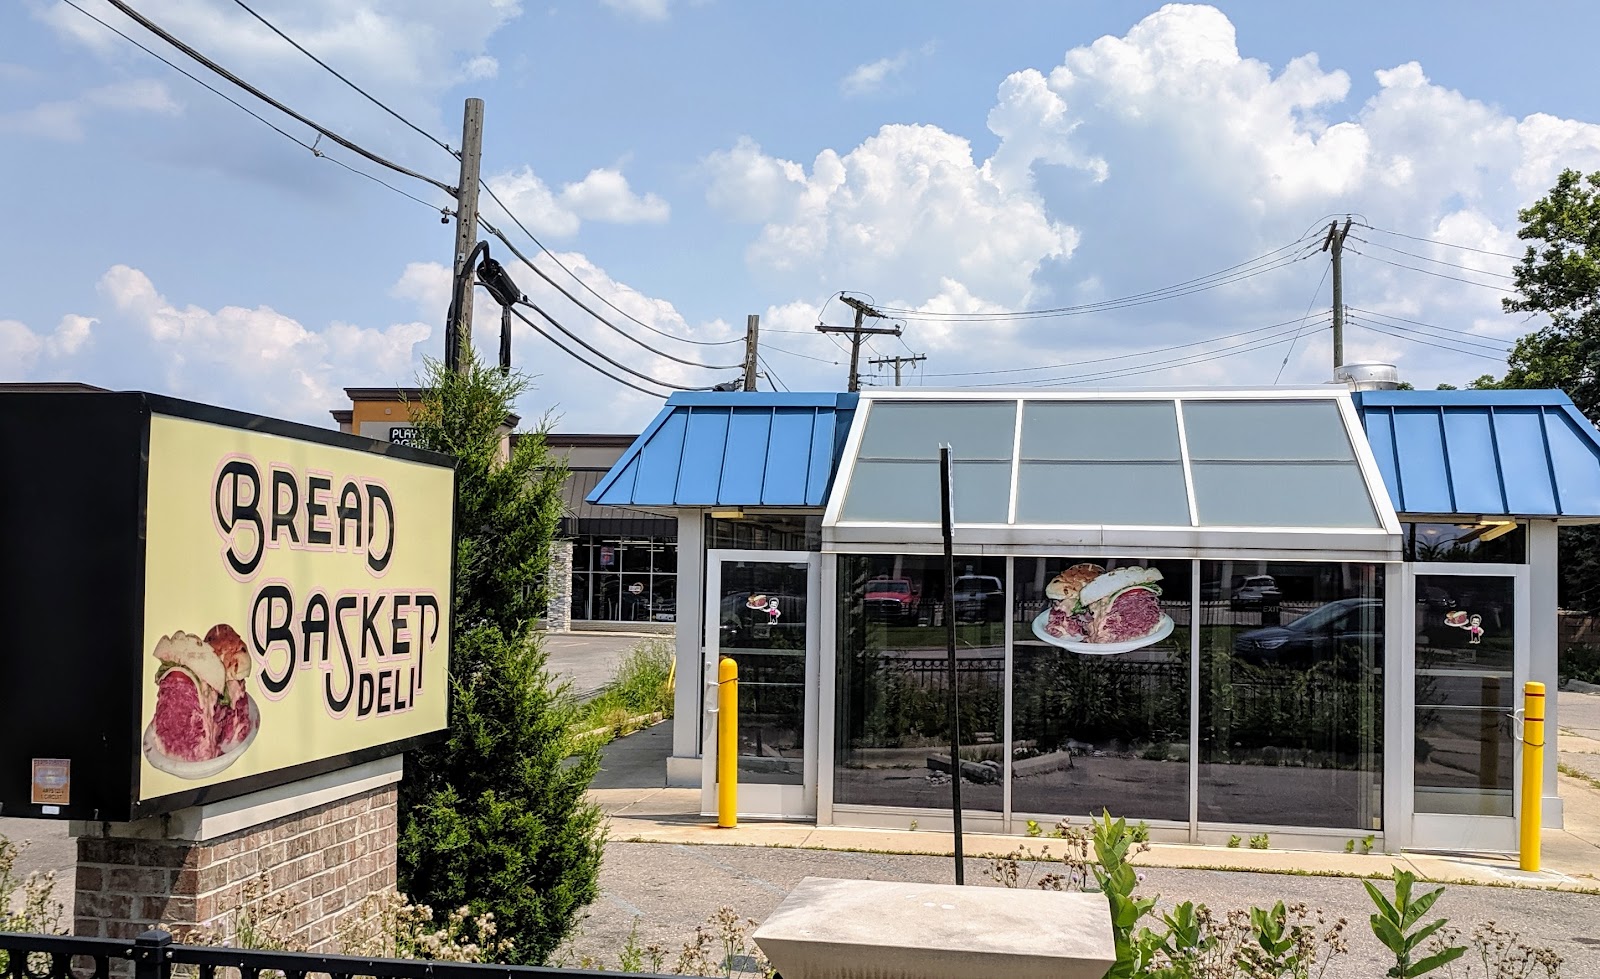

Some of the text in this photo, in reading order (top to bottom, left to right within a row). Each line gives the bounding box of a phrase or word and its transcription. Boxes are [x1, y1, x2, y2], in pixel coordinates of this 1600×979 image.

[392, 428, 417, 439] PLAY
[215, 460, 395, 575] BREAD
[1262, 605, 1280, 613] EXIT
[251, 585, 440, 713] BASKET
[356, 667, 416, 717] DELI
